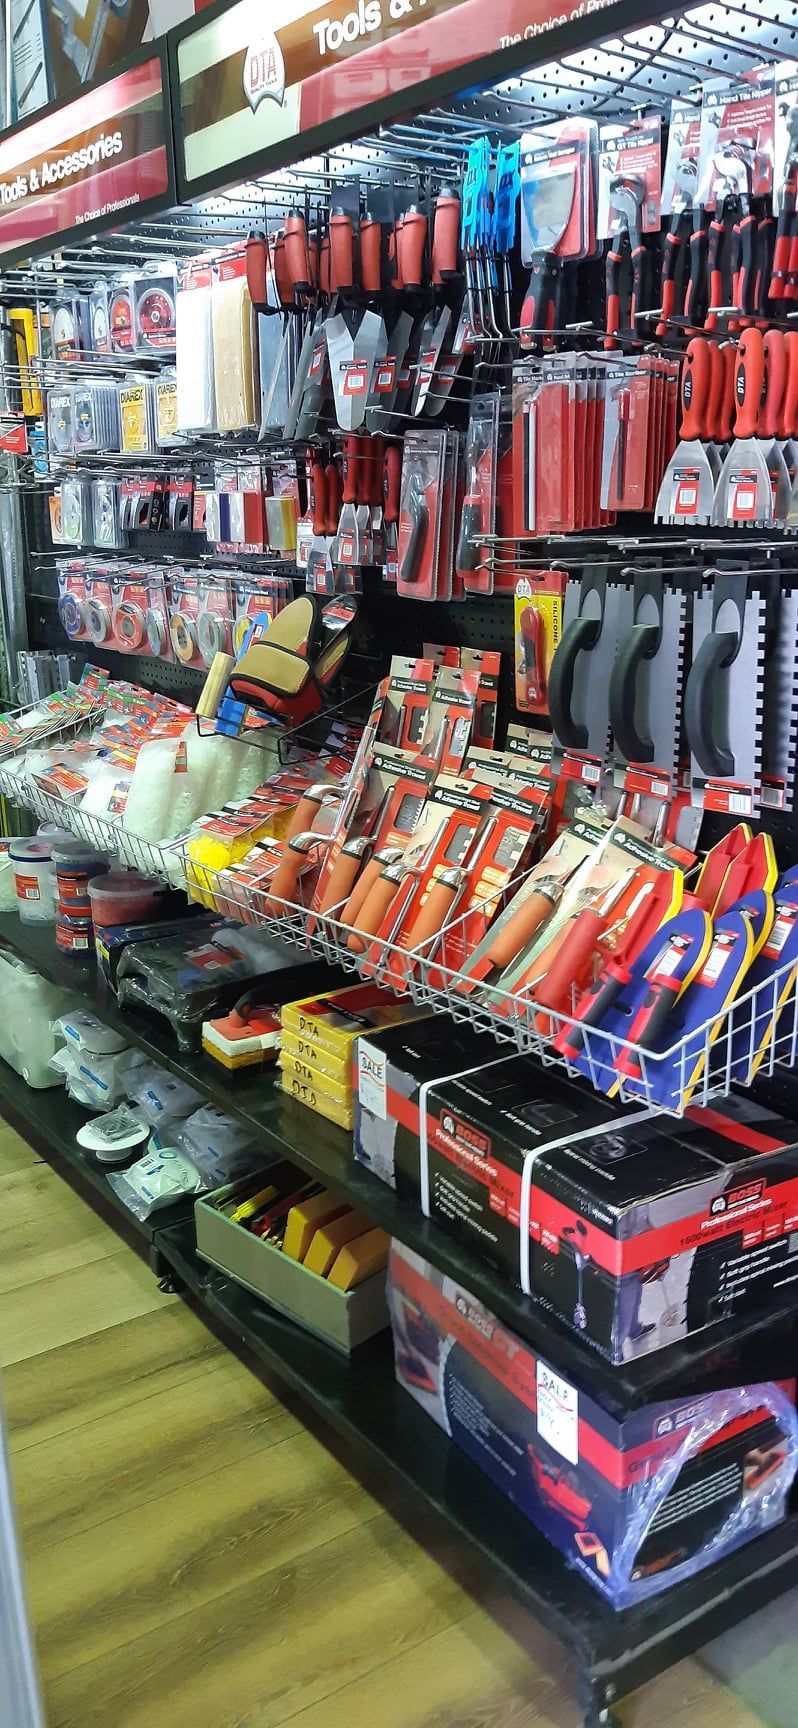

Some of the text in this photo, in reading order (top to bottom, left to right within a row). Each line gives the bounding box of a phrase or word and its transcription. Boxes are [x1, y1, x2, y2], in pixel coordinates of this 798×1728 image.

[313, 0, 382, 55] Tools
[500, 34, 522, 49] The
[524, 15, 567, 39] Choice
[0, 131, 123, 205] Tools & Accessories
[75, 193, 140, 225] The Choice of Professionals
[50, 396, 71, 409] DIAREX
[517, 585, 530, 594] DTA
[382, 763, 427, 780] Adhesive Trowel
[442, 795, 481, 811] Adhesive Trowel
[510, 802, 533, 815] Trowel
[624, 842, 675, 871] Adhesive Trow
[299, 1017, 320, 1037] DTA
[298, 1040, 317, 1060] DTA
[294, 1060, 314, 1081] DTA
[362, 1056, 383, 1079] SALE
[291, 1080, 317, 1106] DTA
[728, 1183, 762, 1203] BOSS
[701, 1207, 747, 1230] Professional
[746, 1198, 772, 1213] Series
[726, 1212, 760, 1230] Electric
